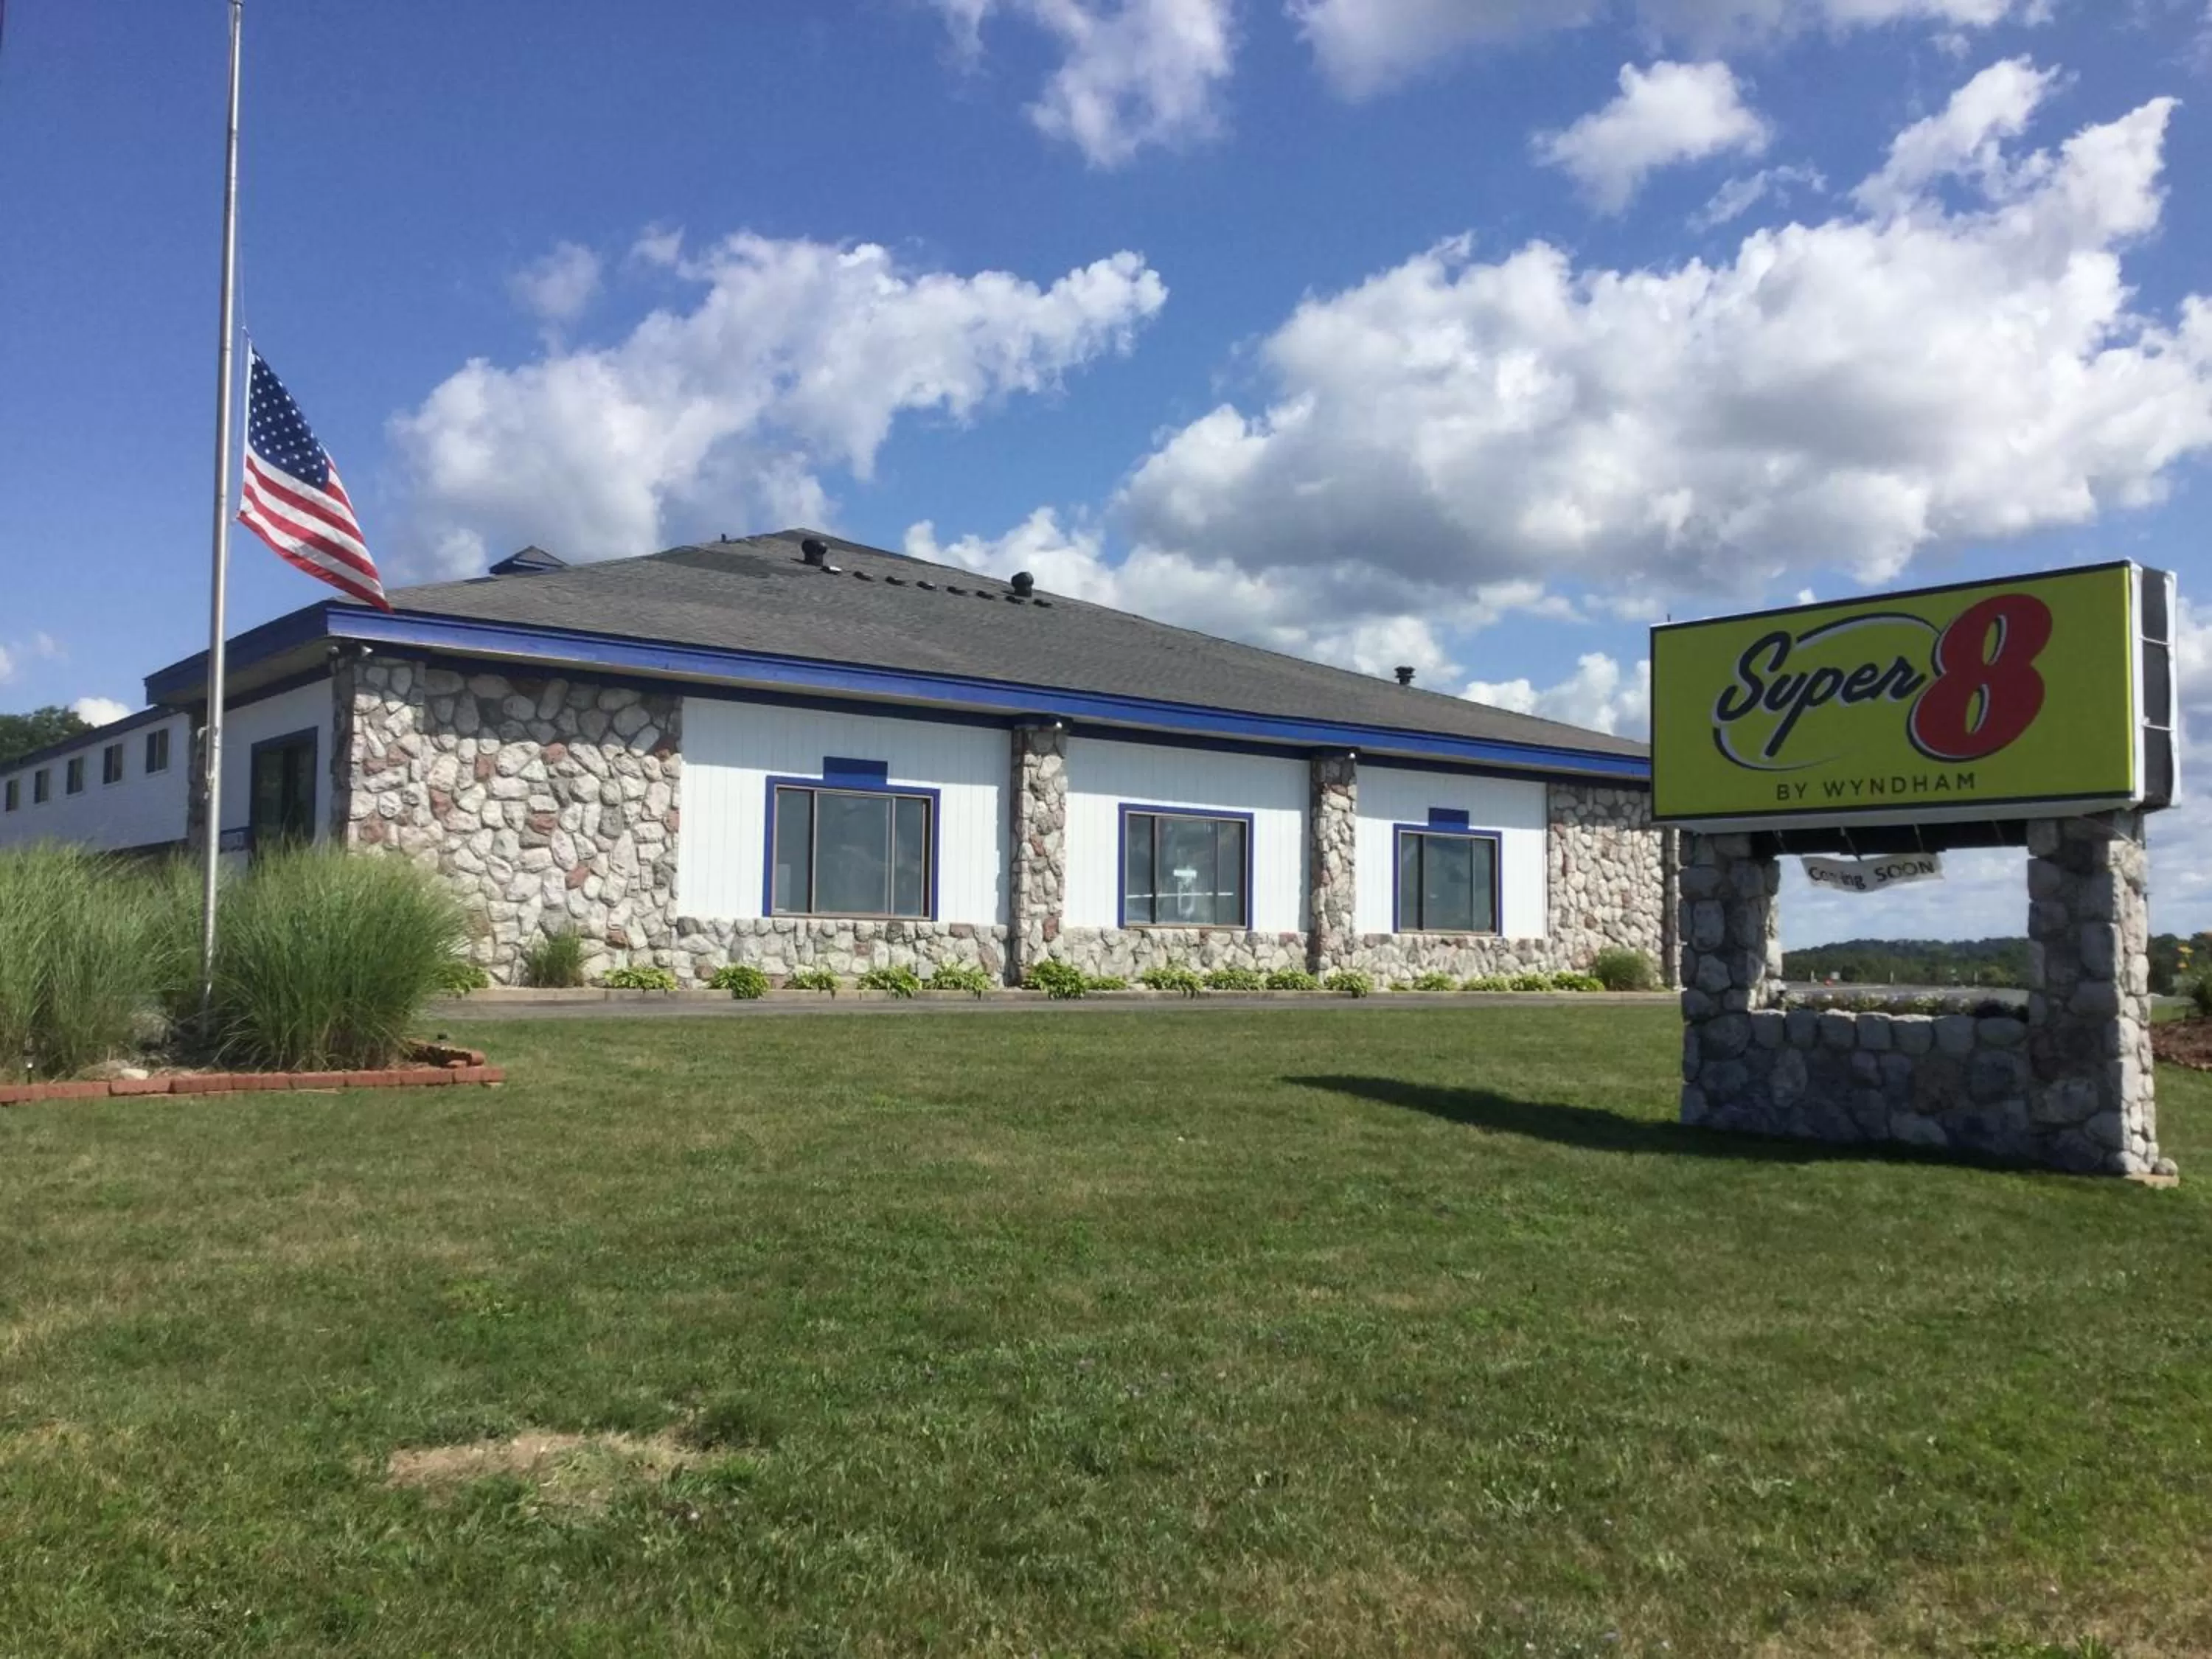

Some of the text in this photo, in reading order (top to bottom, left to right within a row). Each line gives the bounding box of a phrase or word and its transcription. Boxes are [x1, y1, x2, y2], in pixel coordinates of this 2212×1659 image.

[1715, 593, 2053, 762] Super 8
[1776, 772, 1975, 801] BY WYNDHAM
[1874, 860, 1935, 882] SOON
